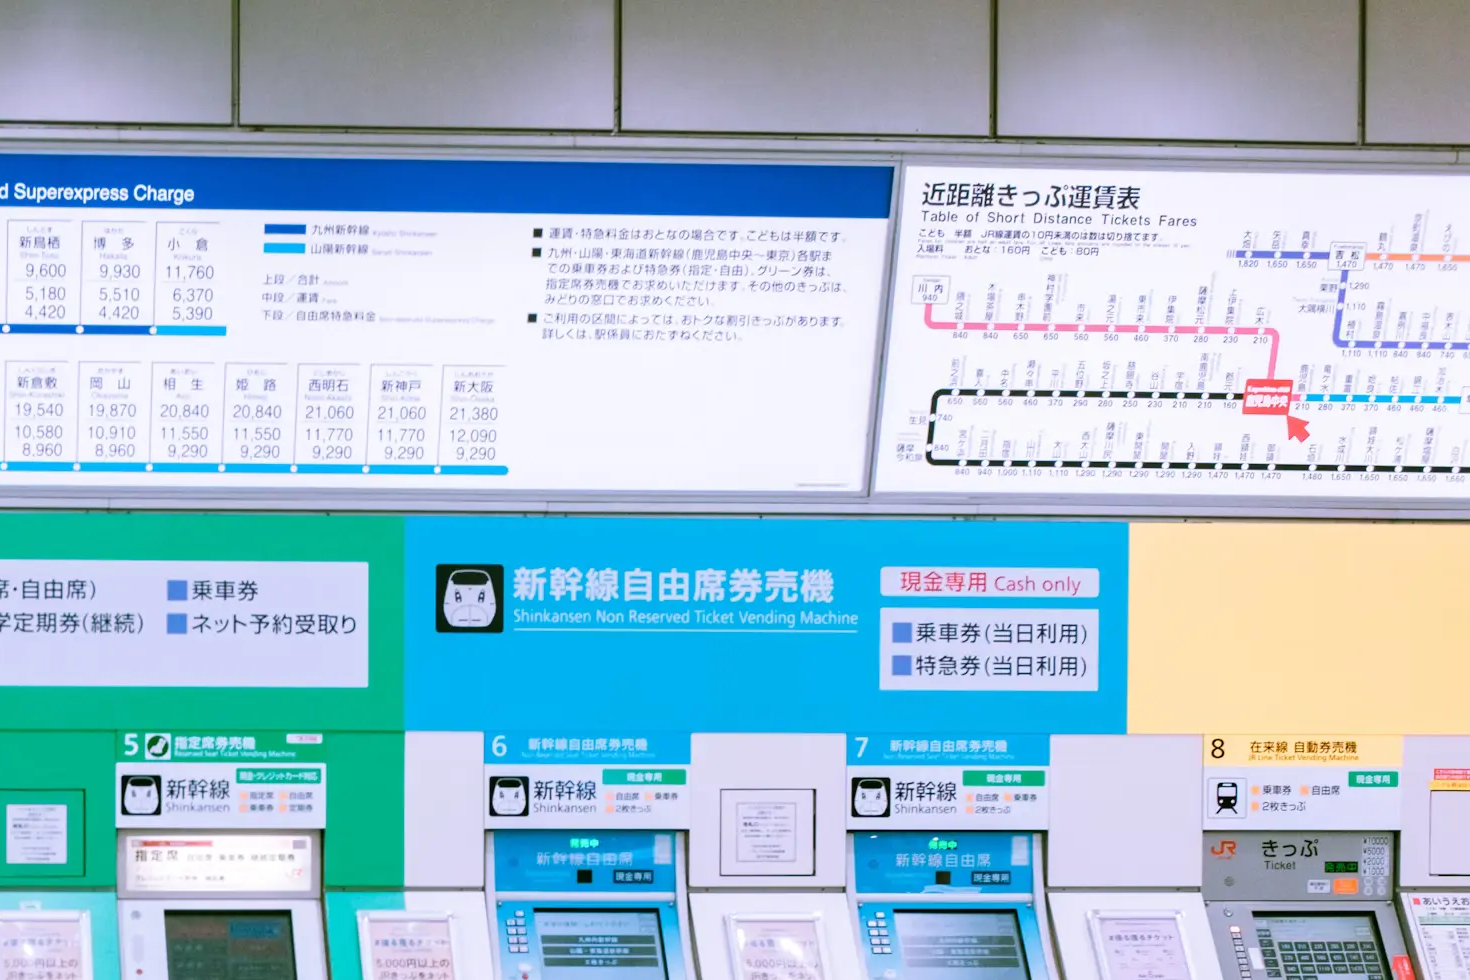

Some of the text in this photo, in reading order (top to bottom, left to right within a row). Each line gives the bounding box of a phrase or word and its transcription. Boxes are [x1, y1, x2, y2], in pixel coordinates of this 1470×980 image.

[14, 185, 129, 203] Superexpress
[133, 186, 195, 206] Charge
[921, 182, 1142, 210] 近距離きっぷ運賃表
[922, 211, 1198, 227] Table of Short Distance Tickets Fares
[25, 263, 67, 280] 9,600
[165, 265, 215, 282] 11,760
[172, 306, 214, 322] 5,390
[88, 403, 137, 420] 19,870
[160, 403, 210, 420] 20,840
[305, 405, 355, 422] 21,060
[449, 406, 499, 423] 21,380
[455, 446, 496, 461] 9,290
[191, 579, 259, 603] 乗車券
[512, 566, 1082, 604] 新幹線自由席券売機 現金専用 Cash only
[192, 613, 358, 636] ネット予約受取り
[512, 607, 859, 629] Shinkansen Non Reserved Ticket Vending Machine
[124, 733, 139, 756] 5
[491, 735, 507, 757] 6
[854, 737, 869, 759] 7
[1210, 738, 1226, 759] 8
[1250, 741, 1358, 754] 在来線 自動券売機
[165, 779, 231, 800] 新幹線
[533, 779, 597, 801] 新幹線
[894, 781, 957, 802] 新幹線
[1262, 785, 1341, 796] 乗車券 自由席
[165, 802, 231, 813] Shinkansen
[533, 803, 597, 814] Shinkansen
[894, 803, 957, 815] Shinkansen
[1210, 839, 1238, 856] JR
[1261, 838, 1320, 859] きっぷ
[1264, 860, 1297, 870] Ticket
